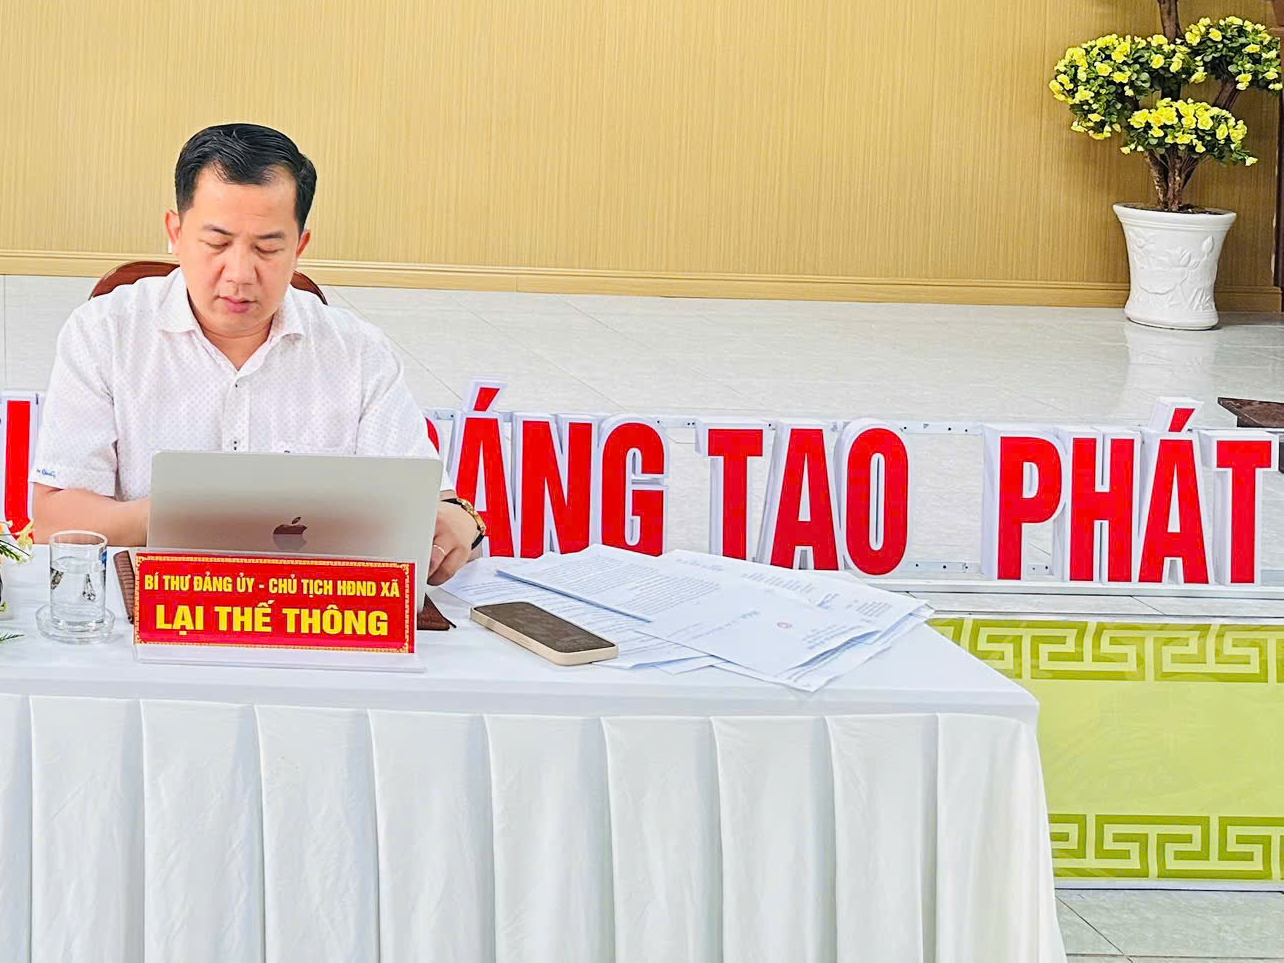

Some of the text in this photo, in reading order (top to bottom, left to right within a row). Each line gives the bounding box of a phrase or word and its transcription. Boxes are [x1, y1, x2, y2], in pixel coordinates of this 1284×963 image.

[425, 387, 664, 558] ÁNG
[998, 409, 1270, 582] PHÁT
[143, 571, 159, 590] BÍ
[163, 575, 191, 592] THƯ
[193, 571, 233, 593] ĐẢNG
[235, 572, 255, 594] ỦY
[268, 573, 297, 596] CHỦ
[301, 578, 333, 598] TỊCH
[337, 580, 377, 597] HĐND
[380, 579, 401, 598] XÃ
[156, 599, 389, 636] LẠI THẾ THÔNG
